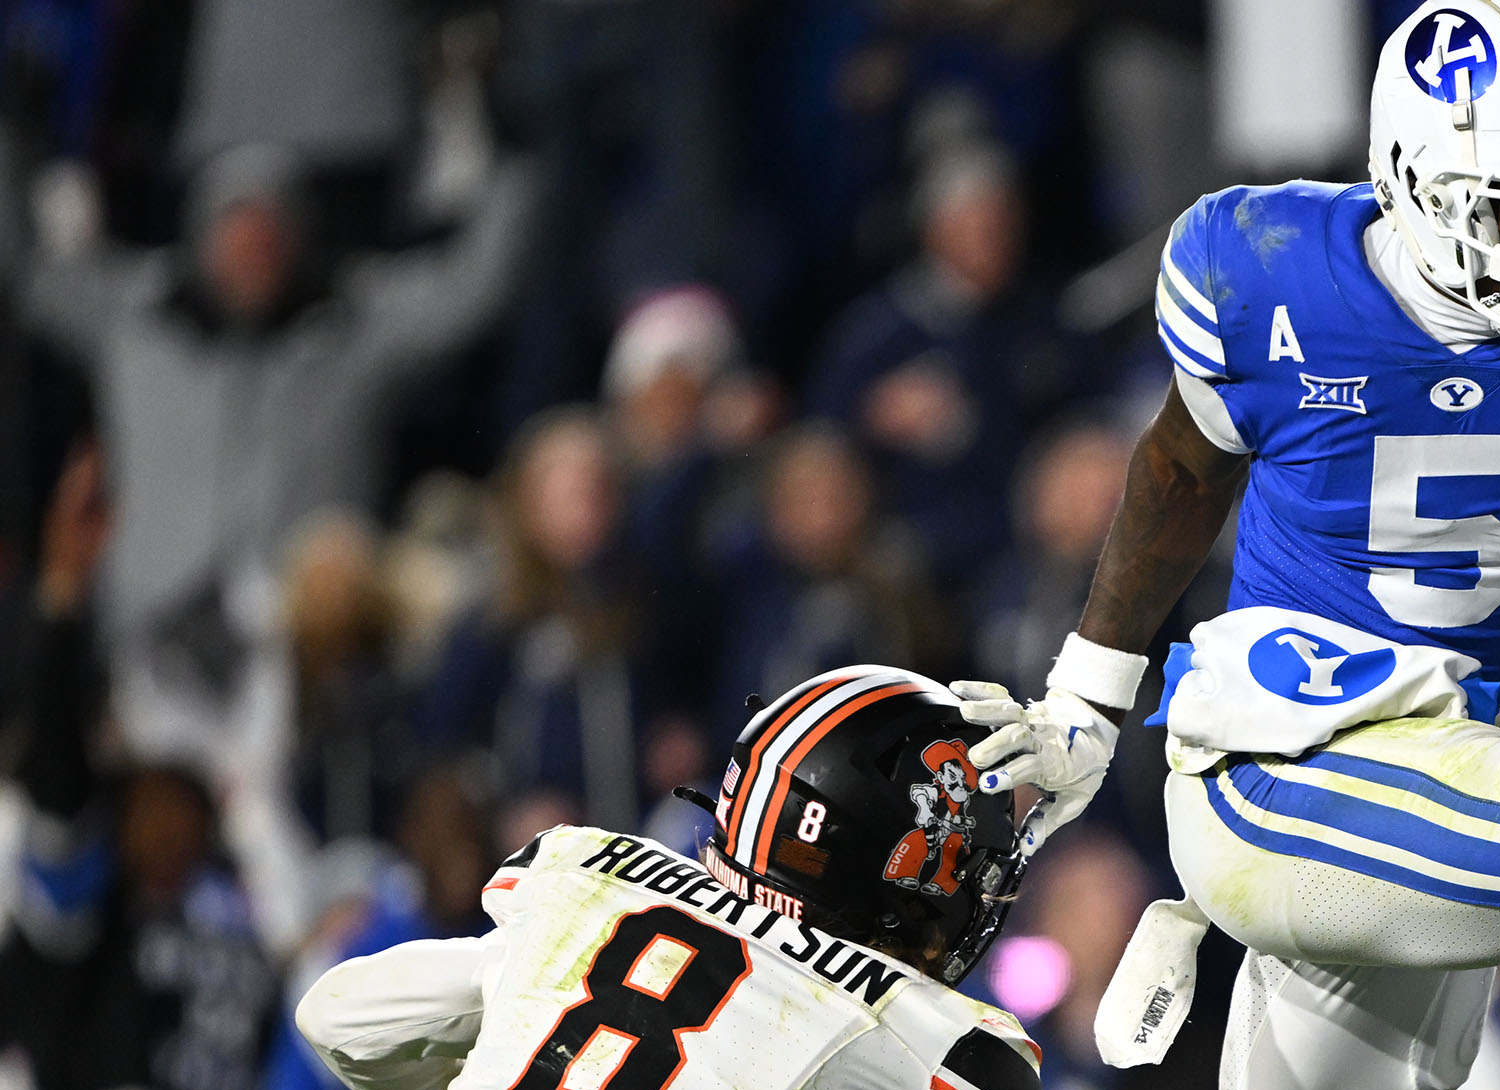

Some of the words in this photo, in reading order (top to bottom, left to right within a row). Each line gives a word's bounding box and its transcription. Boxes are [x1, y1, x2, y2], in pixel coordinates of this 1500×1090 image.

[1268, 305, 1305, 363] A
[1441, 383, 1474, 407] Y
[1275, 633, 1350, 697] Y
[797, 800, 827, 843] 8
[754, 884, 803, 922] STATE
